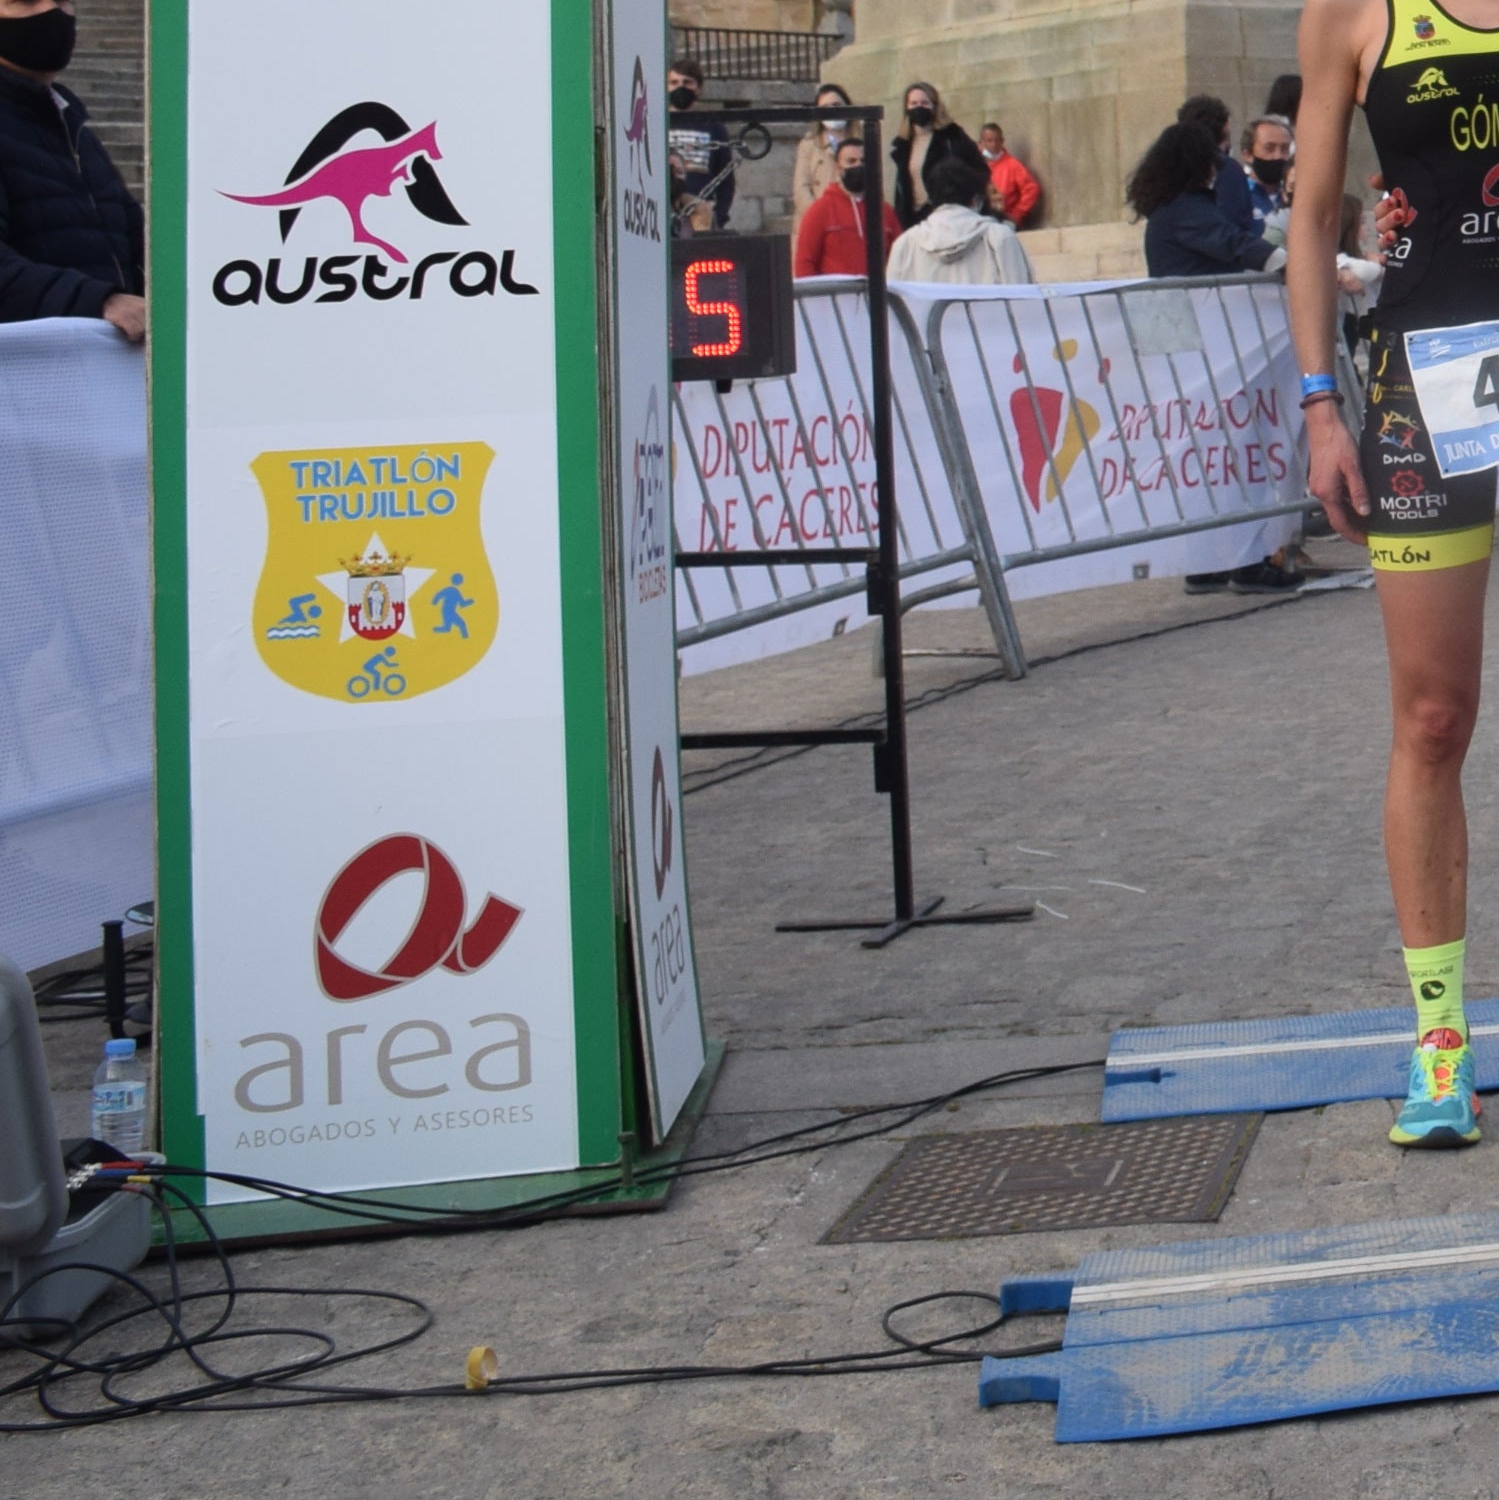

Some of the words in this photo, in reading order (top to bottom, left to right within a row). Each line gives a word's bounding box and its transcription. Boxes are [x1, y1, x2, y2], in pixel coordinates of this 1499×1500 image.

[212, 250, 540, 306] austral
[290, 451, 460, 489] TRIATLÓN
[1443, 439, 1486, 463] JUNTA
[296, 488, 455, 522] TRUJILLO
[1381, 495, 1447, 510] MOTRI
[652, 904, 685, 1004] area
[233, 1012, 532, 1114] area
[236, 1118, 375, 1149] ABOGADOS
[387, 1115, 400, 1132] Y
[414, 1103, 534, 1133] ASESORES
